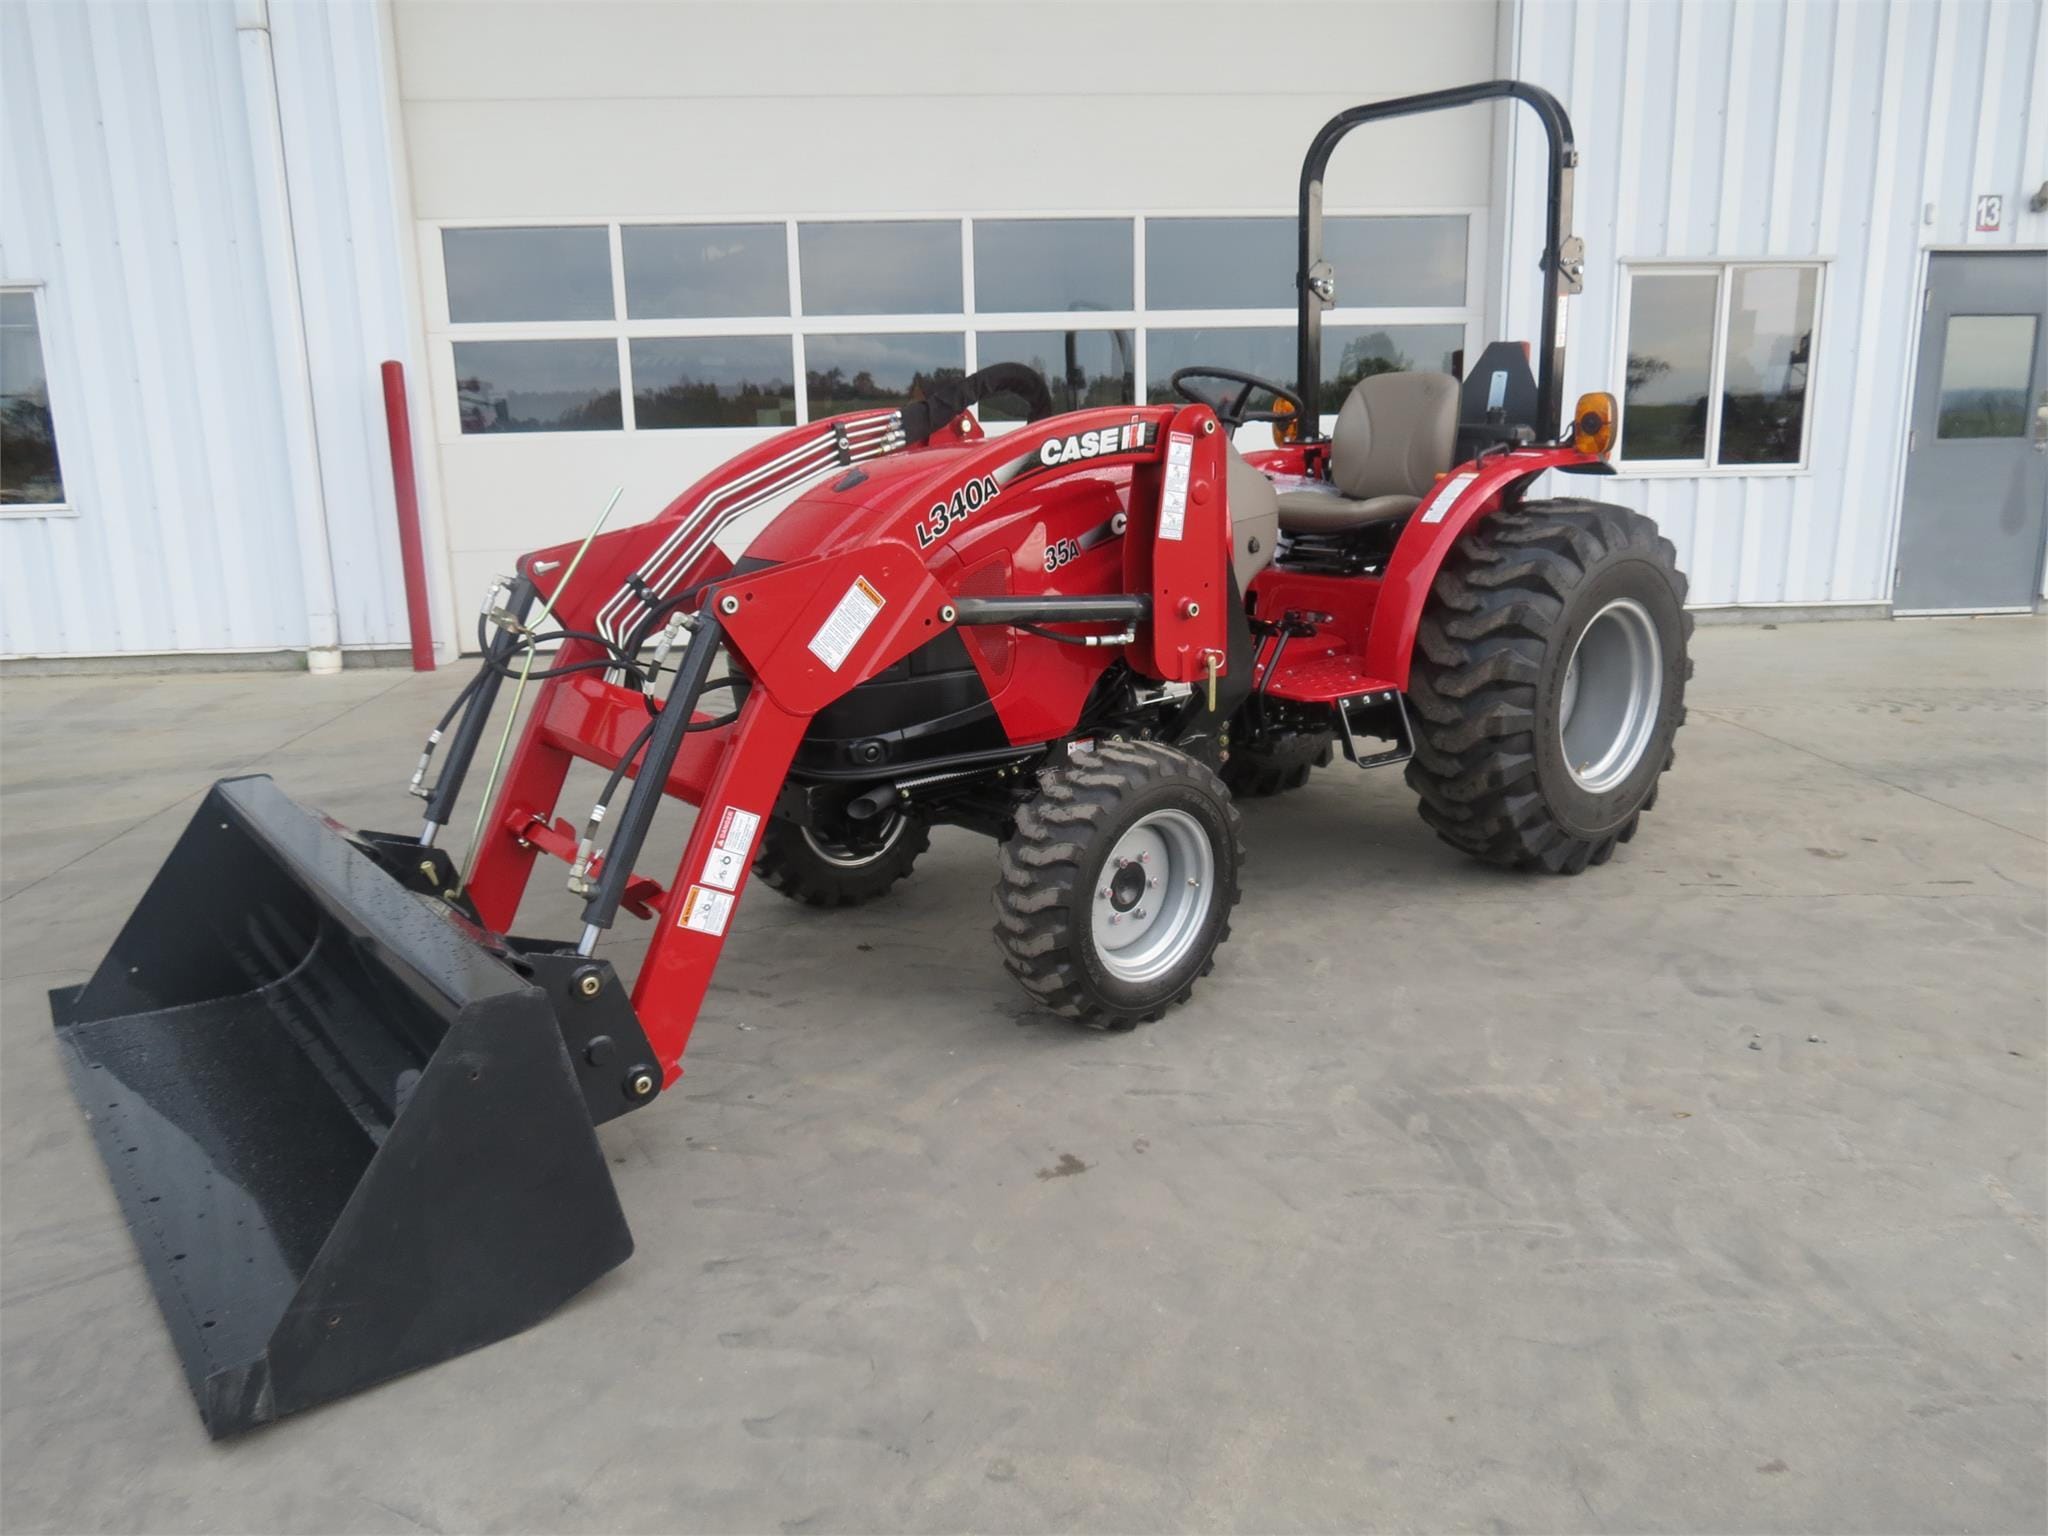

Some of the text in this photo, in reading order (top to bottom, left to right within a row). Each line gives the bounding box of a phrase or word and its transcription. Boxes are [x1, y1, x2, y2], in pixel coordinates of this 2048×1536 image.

[1977, 196, 2001, 227] 13
[1040, 427, 1119, 466] CASE
[916, 475, 998, 548] L340A
[1044, 536, 1080, 572] 35A
[719, 810, 735, 841] DANGER
